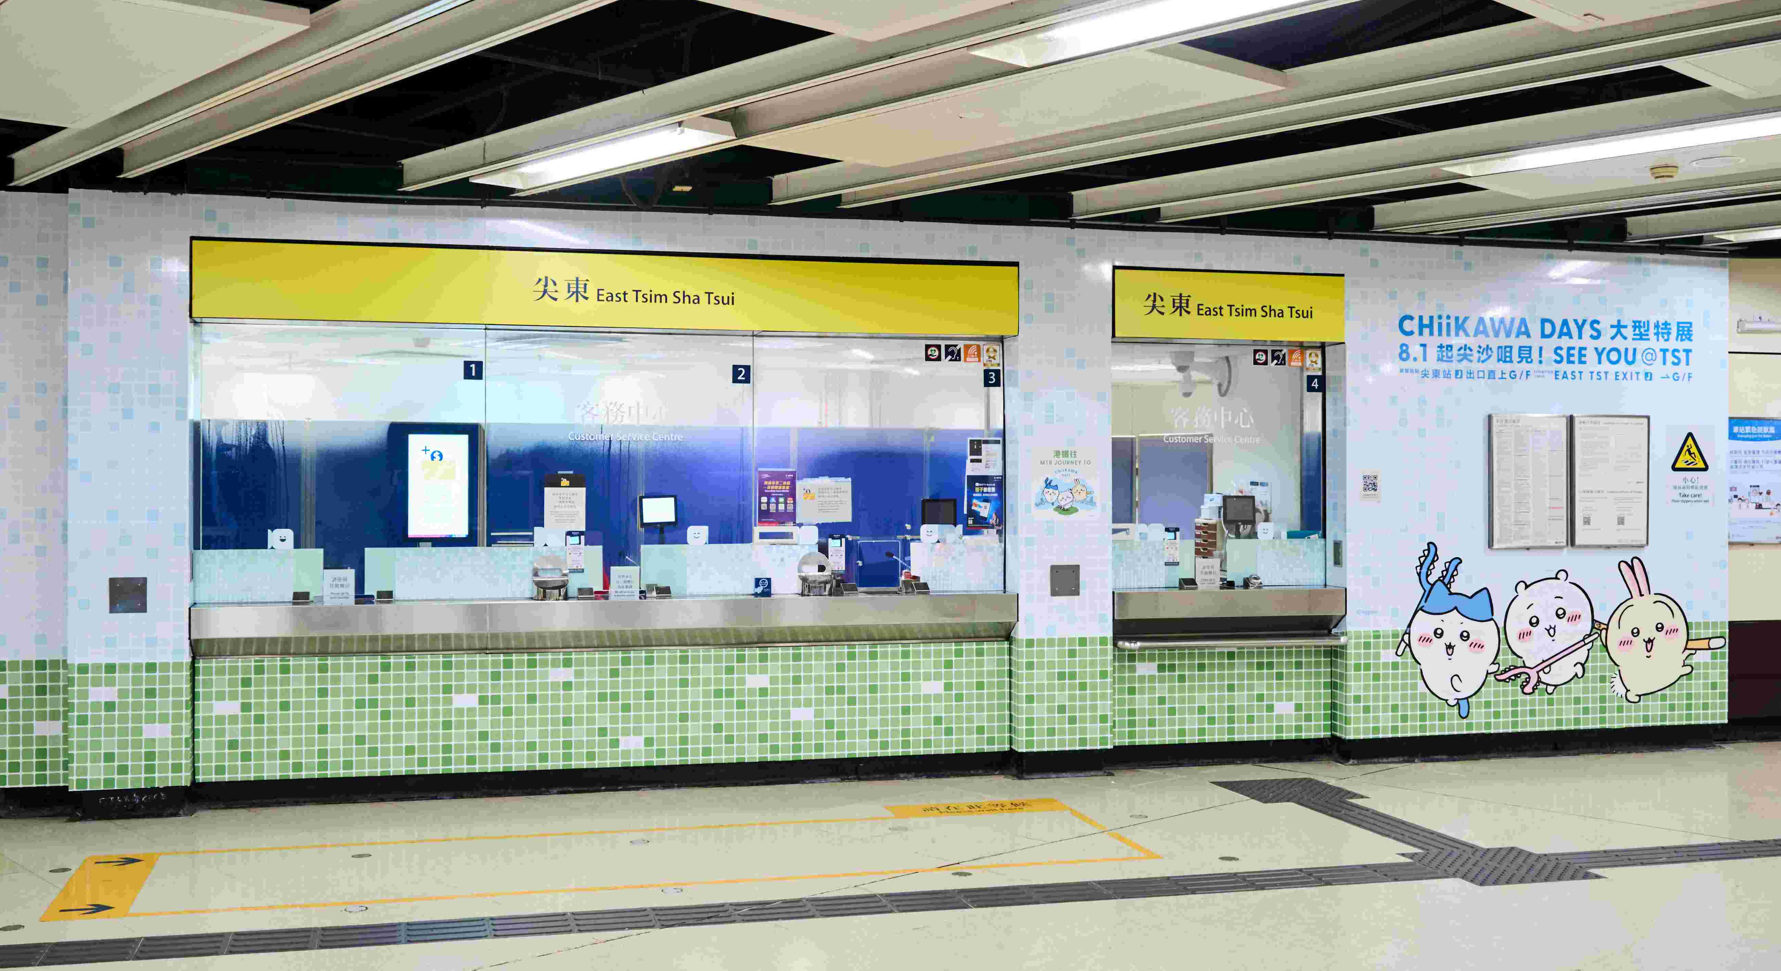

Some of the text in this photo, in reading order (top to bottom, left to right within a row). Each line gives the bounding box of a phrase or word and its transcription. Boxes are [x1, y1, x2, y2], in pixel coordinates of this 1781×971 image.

[533, 276, 735, 306] 尖東 East Tsim Sha Tsui
[1143, 291, 1313, 319] 尖東 East Tsim Sha Tsui
[1398, 314, 1693, 342] CHiiKAWA DAYS 大型特展
[1398, 342, 1428, 363] 8.1
[1553, 345, 1588, 365] SEE
[1593, 346, 1638, 366] YOU
[1641, 347, 1693, 366] @TST
[736, 367, 746, 380] 2
[988, 371, 996, 384] 3
[1554, 370, 1583, 381] EAST
[1589, 370, 1610, 381] TST
[1614, 371, 1641, 382] EXIT
[1672, 372, 1693, 382] G/F
[1310, 378, 1320, 390] 4
[568, 431, 684, 442] Customer Service Centre
[1163, 434, 1262, 444] Customer Service Centre
